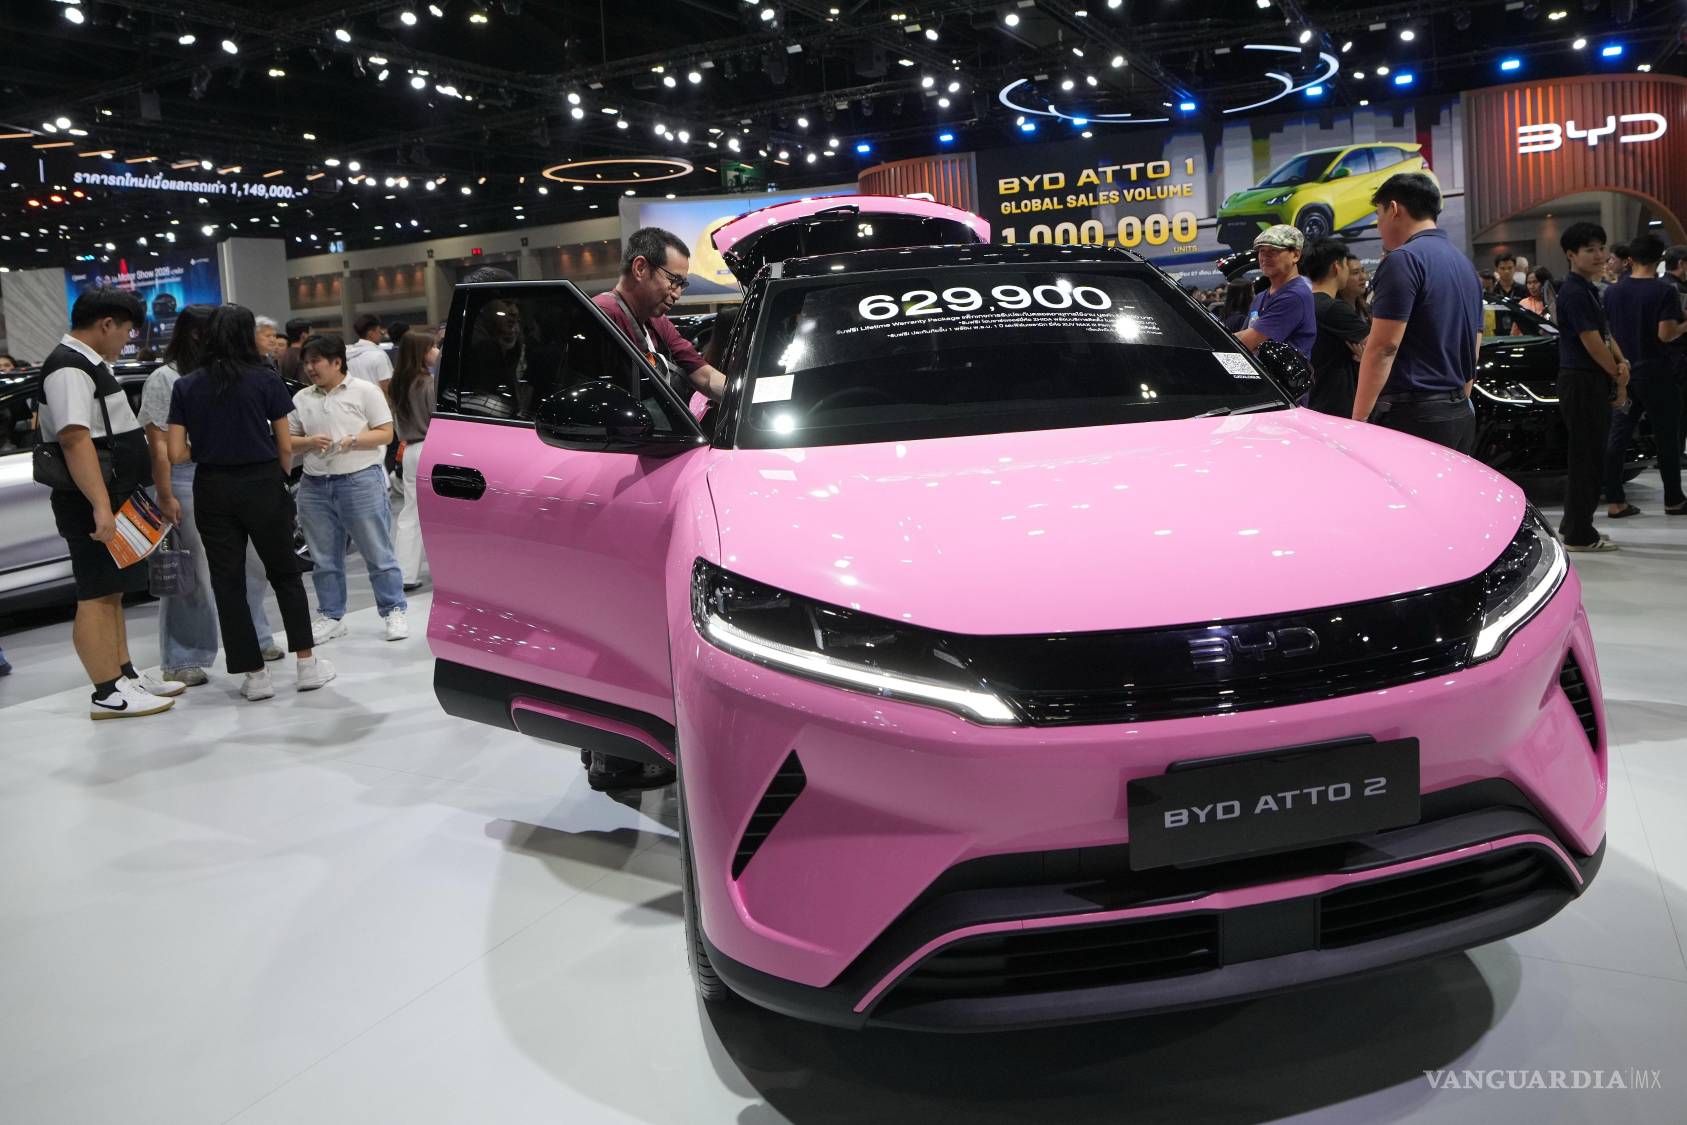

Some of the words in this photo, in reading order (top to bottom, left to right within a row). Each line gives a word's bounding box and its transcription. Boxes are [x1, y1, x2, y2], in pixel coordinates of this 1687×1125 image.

[1518, 112, 1667, 154] BYD
[74, 171, 227, 194] ราคารถใหม่เมื่อแลกรถเก่า
[998, 172, 1066, 195] BYD
[1077, 160, 1171, 187] ATTO
[1184, 157, 1194, 176] 1
[1000, 196, 1063, 215] GLOBAL
[1066, 190, 1120, 208] SALES
[1123, 183, 1193, 202] VOLUME
[1173, 245, 1199, 253] UNITS
[860, 323, 890, 332] Lifetime
[892, 319, 926, 327] Warranty
[928, 314, 960, 323] Package
[1188, 627, 1320, 666] BYD
[1164, 800, 1241, 829] BYD
[1254, 782, 1351, 814] ATTO
[1364, 776, 1387, 796] 2
